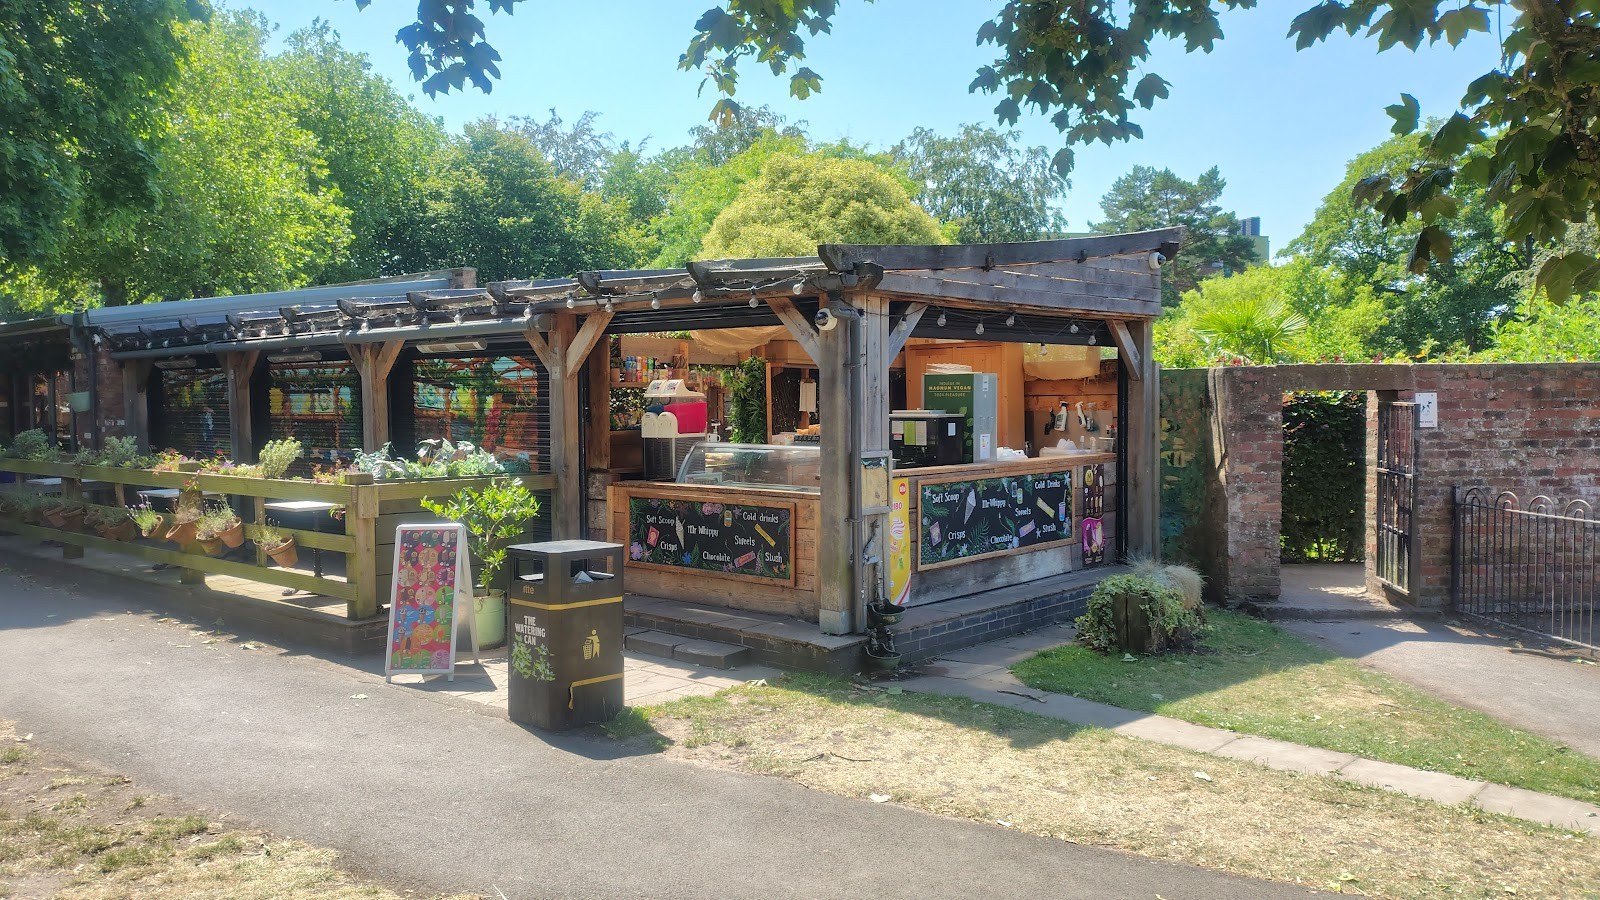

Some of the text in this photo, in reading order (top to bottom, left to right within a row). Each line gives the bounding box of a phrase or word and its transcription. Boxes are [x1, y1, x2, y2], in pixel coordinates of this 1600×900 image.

[1034, 479, 1061, 490] Cold Drinks
[932, 492, 960, 504] Soft Scoop
[742, 511, 779, 524] Cold drinks
[1014, 507, 1032, 517] Sweets
[646, 514, 675, 527] Soft Scoop
[687, 525, 719, 537] Mr Whippy
[1042, 522, 1057, 533] Slush
[734, 535, 755, 546] Sweets
[948, 530, 966, 541] Crisps
[990, 533, 1013, 545] Chocolate
[660, 541, 678, 552] Crisps
[702, 550, 731, 562] Chocolate
[764, 552, 782, 563] Slush
[523, 615, 536, 626] THE
[514, 622, 546, 637] WATERING
[523, 635, 536, 645] CAN
